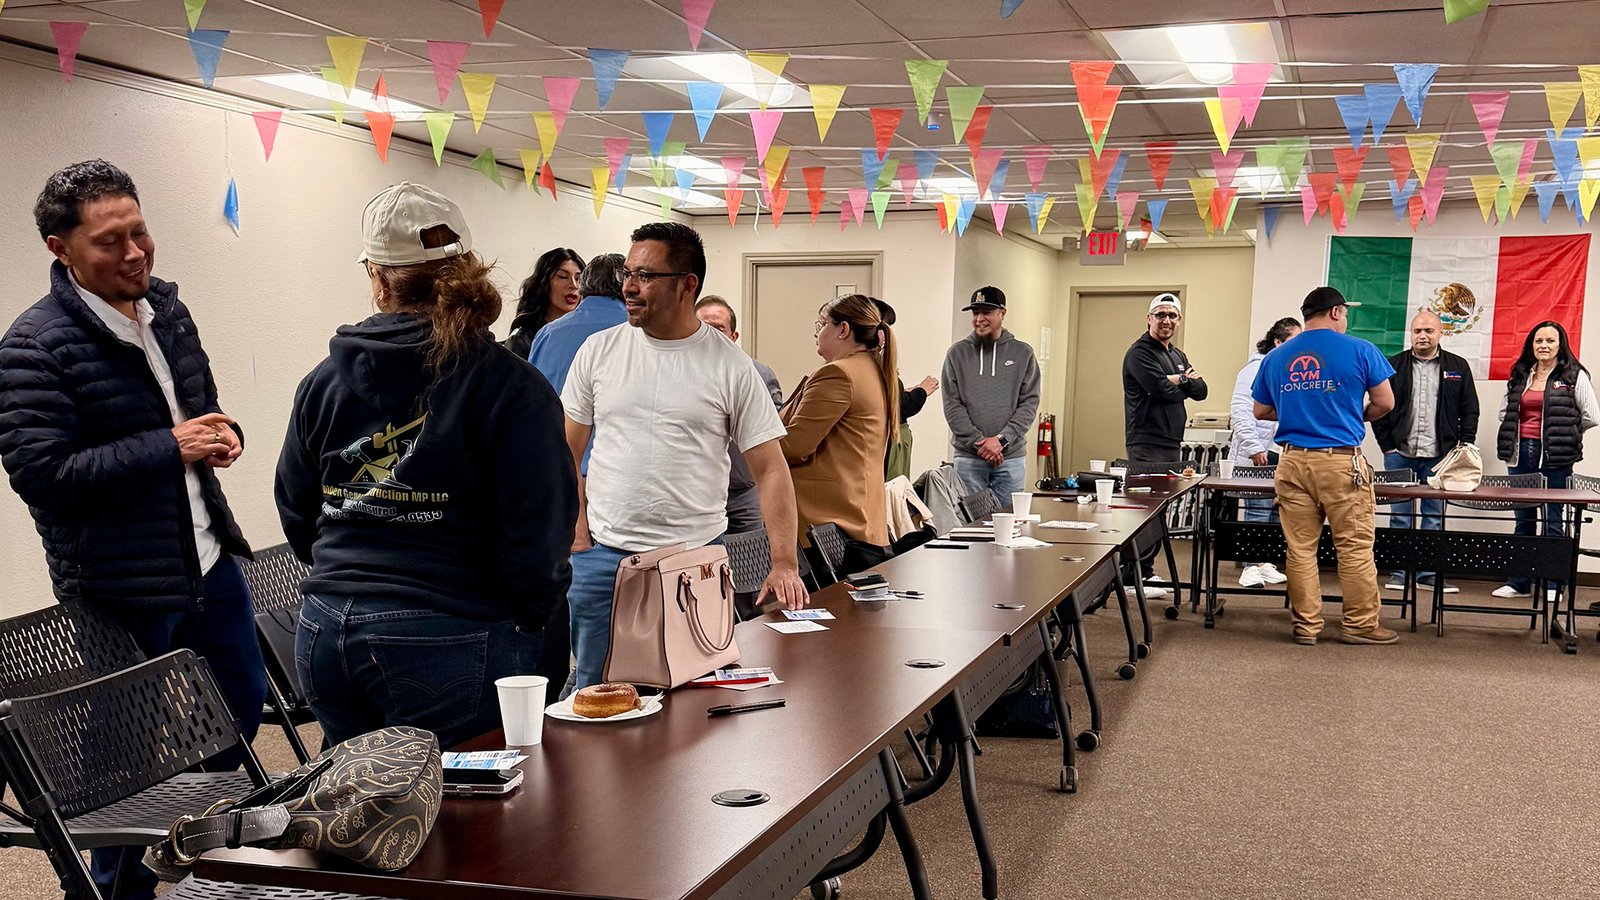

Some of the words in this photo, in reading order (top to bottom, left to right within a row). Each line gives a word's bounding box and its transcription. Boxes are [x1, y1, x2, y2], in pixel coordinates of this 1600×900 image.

[1088, 232, 1120, 256] EXIT
[1290, 370, 1320, 382] CYM
[322, 485, 343, 498] olden
[411, 491, 429, 503] MP
[431, 492, 449, 503] LLC
